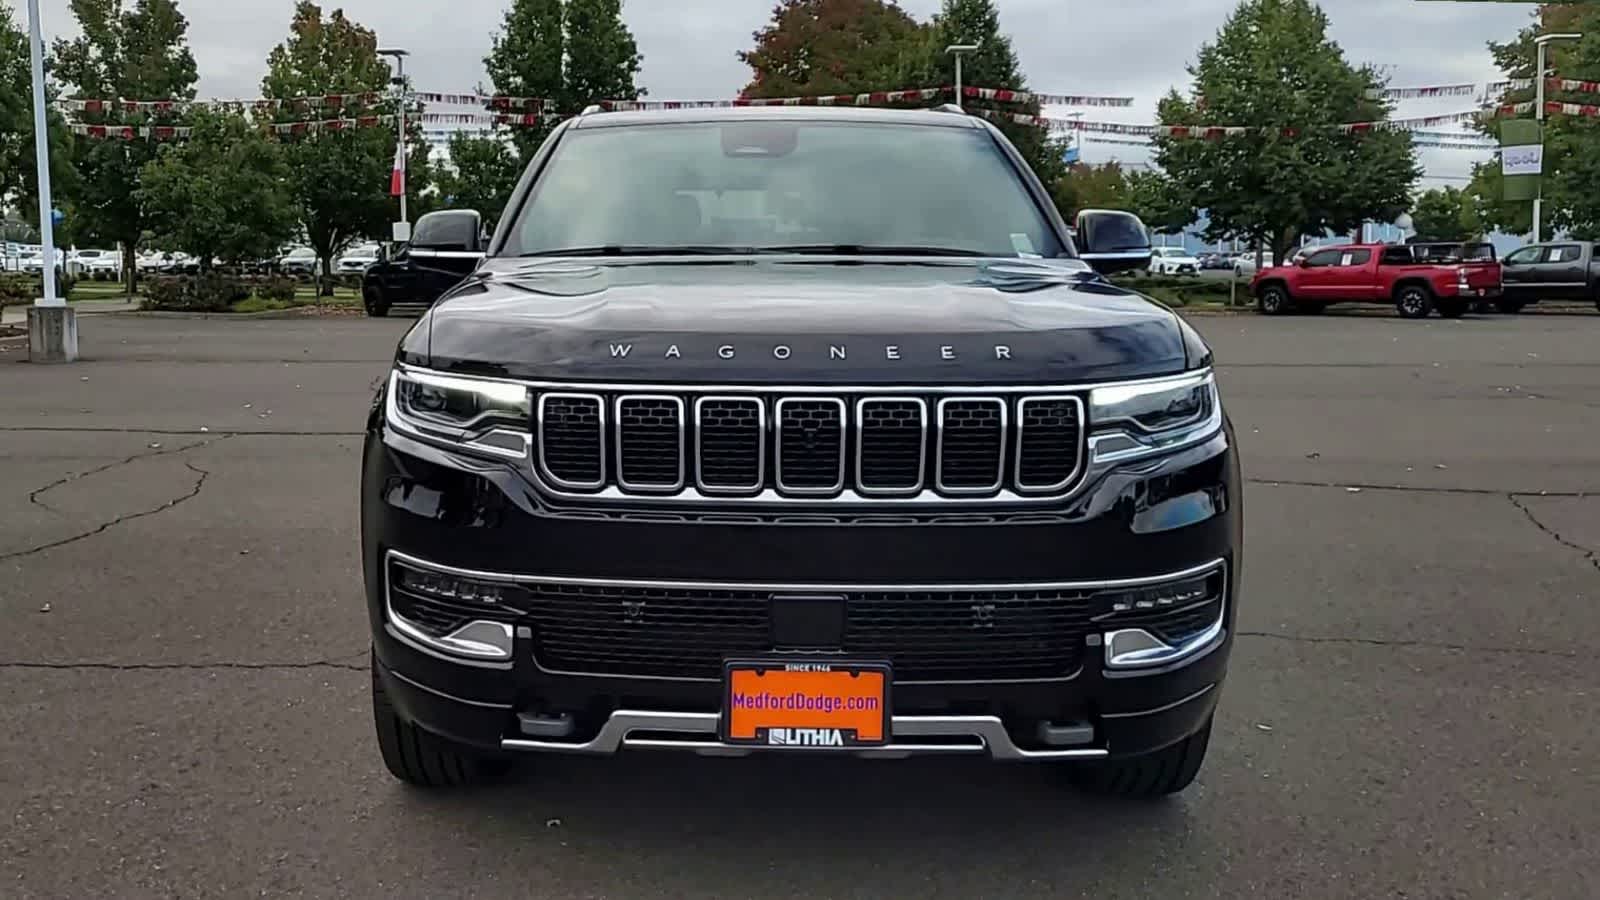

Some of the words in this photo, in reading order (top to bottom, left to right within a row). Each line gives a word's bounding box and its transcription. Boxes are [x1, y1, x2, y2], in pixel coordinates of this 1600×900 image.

[609, 344, 1011, 360] WAGONEER
[785, 664, 810, 672] SINCE
[733, 692, 878, 712] MedfordDodge.com
[786, 728, 844, 745] LITHIA
